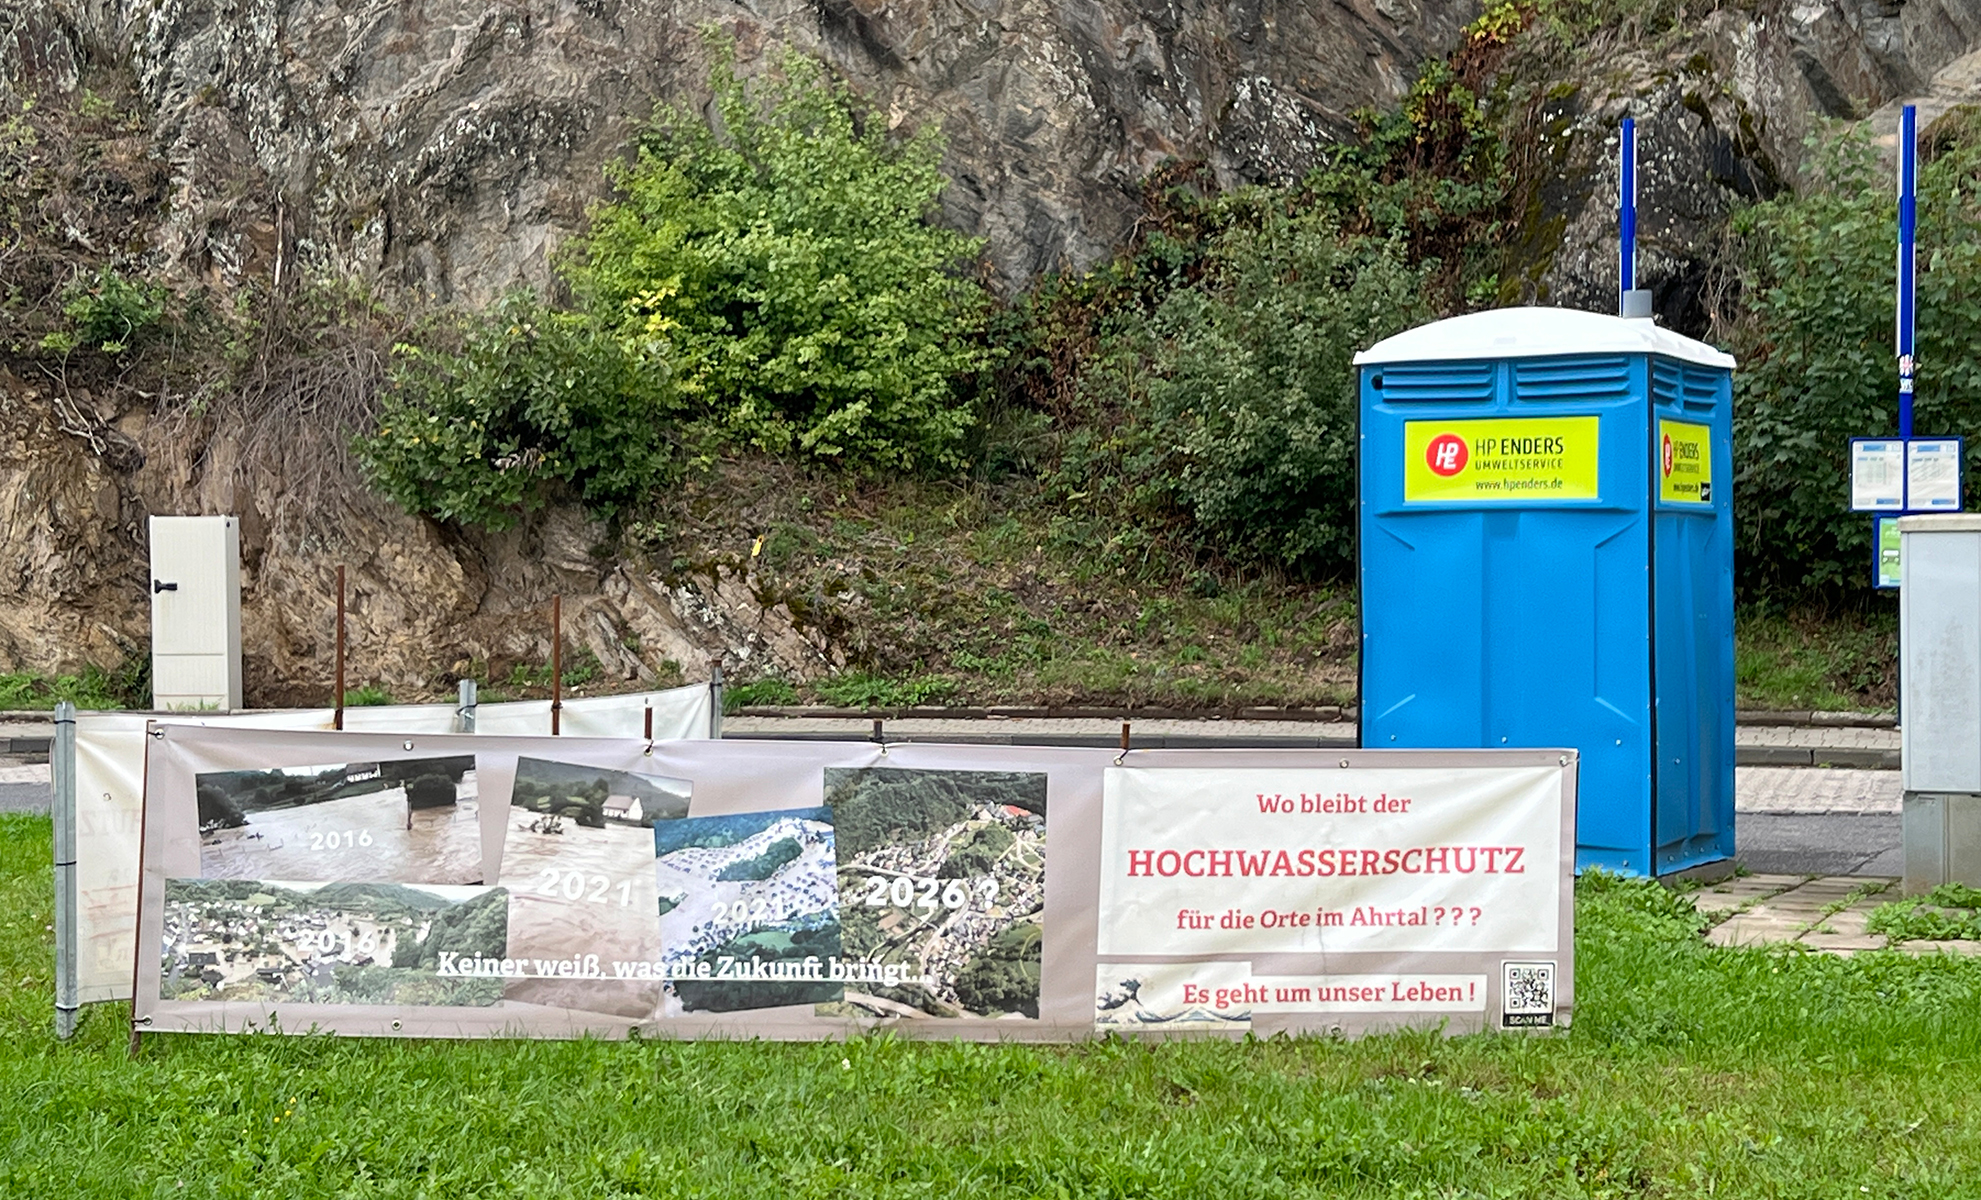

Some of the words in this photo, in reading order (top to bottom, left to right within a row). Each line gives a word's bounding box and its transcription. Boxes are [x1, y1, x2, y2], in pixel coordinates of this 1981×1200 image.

[1475, 438, 1497, 457] HP
[1501, 436, 1564, 456] ENDERS
[1475, 458, 1564, 471] UMWELTSERVICE
[1475, 477, 1564, 492] www.hpenders.de
[1256, 794, 1295, 814] Wo
[1300, 793, 1367, 814] bleibt
[1373, 793, 1412, 814] der
[310, 828, 374, 851] 2016
[1127, 847, 1525, 877] HOCHWASSERSCHUTZ
[536, 867, 633, 907] 2021
[865, 875, 966, 909] 2026
[979, 879, 1001, 910] ?
[711, 897, 785, 925] 2021
[1177, 909, 1215, 930] für
[1220, 909, 1255, 930] die
[1260, 909, 1311, 929] Orte
[1315, 907, 1344, 927] im
[1350, 906, 1428, 927] Ahrtal
[297, 928, 376, 954] 2016
[436, 950, 529, 977] Keiner
[533, 954, 606, 980] weiß,
[612, 960, 666, 979] was
[671, 956, 711, 980] die
[716, 956, 824, 980] Zukunft
[1182, 983, 1210, 1005] Es
[1215, 982, 1269, 1010] geht
[1275, 986, 1311, 1004] um
[1317, 985, 1386, 1003] unser
[1391, 981, 1464, 1002] Leben
